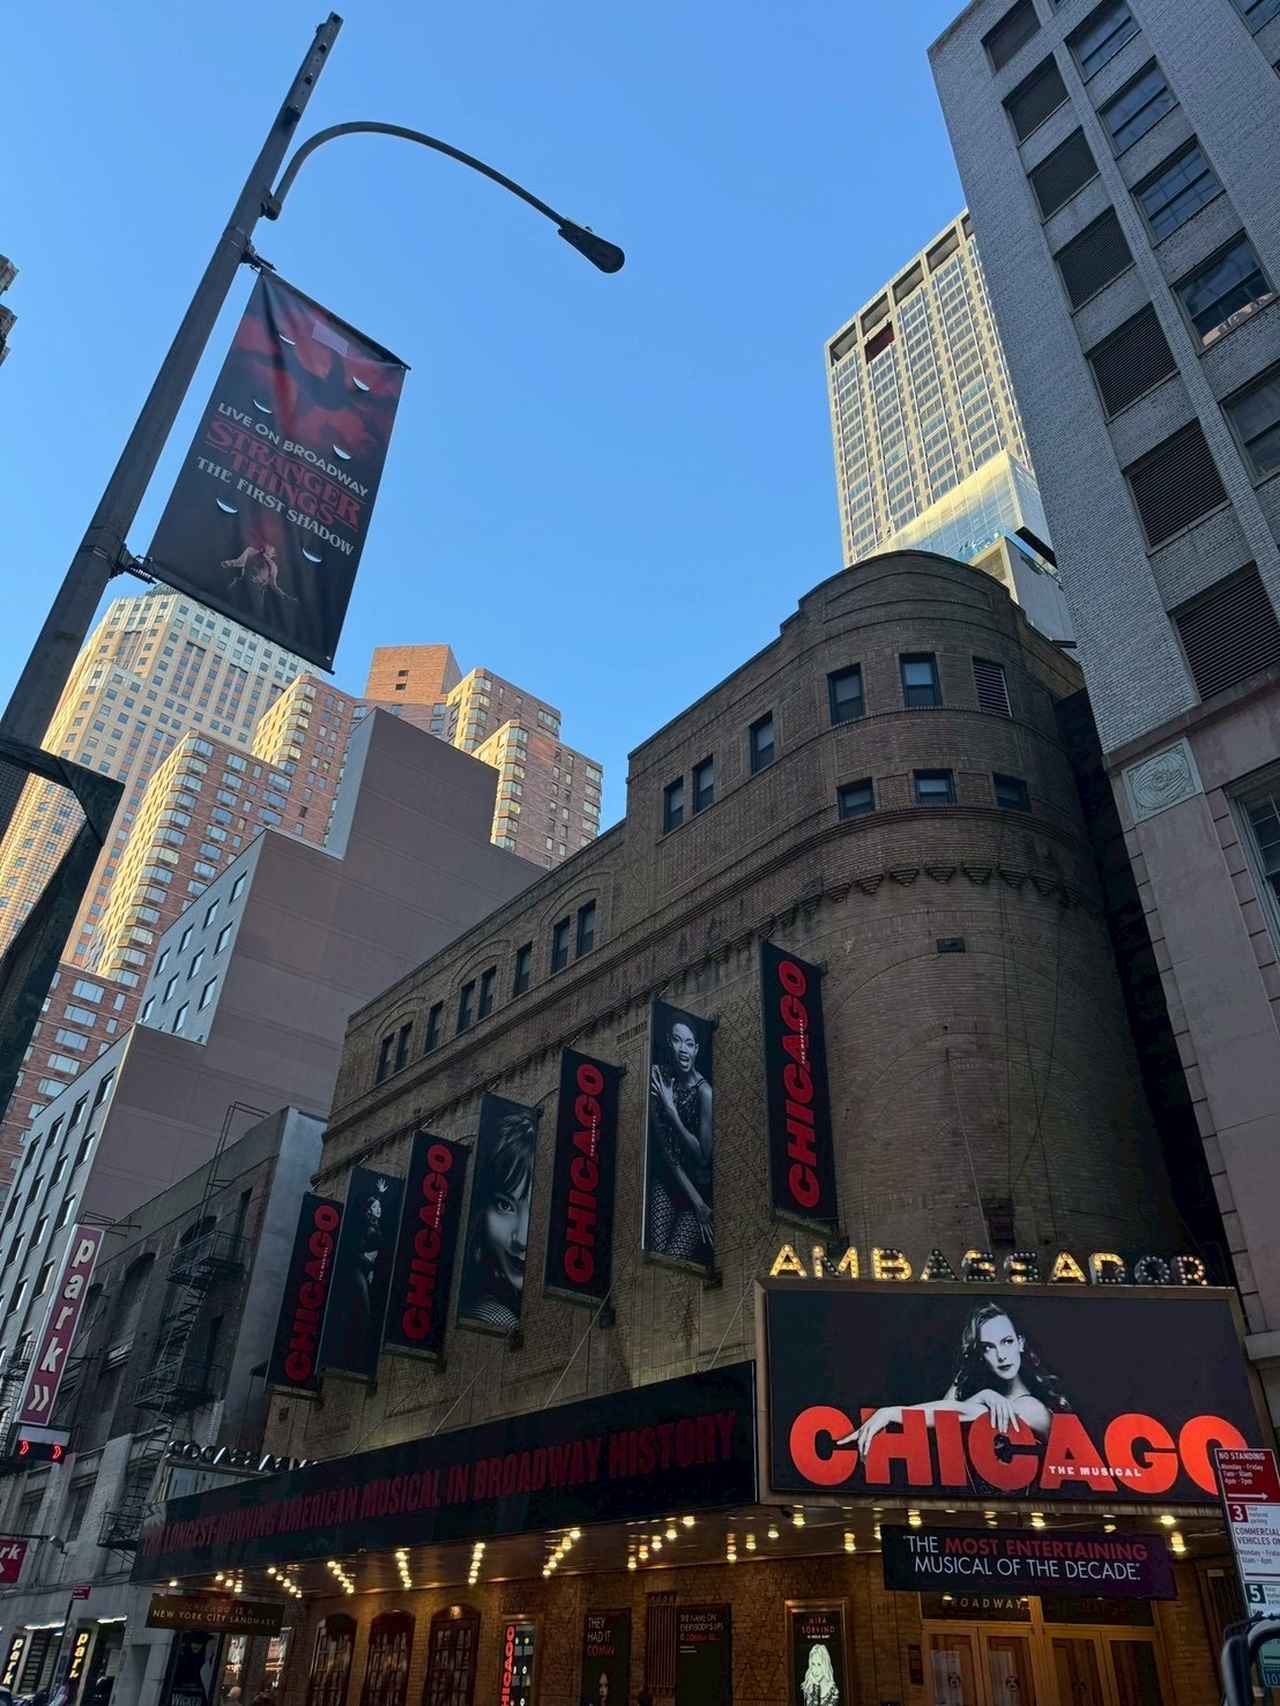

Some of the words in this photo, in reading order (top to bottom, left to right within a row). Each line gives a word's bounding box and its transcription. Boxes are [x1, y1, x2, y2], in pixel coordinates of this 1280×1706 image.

[207, 419, 361, 530] STRANGER
[218, 402, 253, 428] LIVE
[255, 423, 280, 445] ON
[282, 440, 369, 497] BROADWAY
[196, 456, 233, 484] THE
[236, 477, 286, 513] FIRST
[285, 508, 355, 556] SHADOW
[230, 450, 337, 527] THINGS
[778, 959, 820, 1208] CHICAGO
[564, 1063, 605, 1284] CHICAGO
[402, 1143, 452, 1341] CHICAGO
[769, 1243, 1209, 1287] AMBASSADOR
[40, 1238, 96, 1374] park
[284, 1204, 340, 1382] CHICAGO
[360, 1470, 440, 1517] MUSICAL
[447, 1462, 469, 1506] IN
[474, 1438, 601, 1501] BROADWAY
[790, 1405, 1249, 1497] CHICAGO
[1049, 1465, 1075, 1475] THE
[1080, 1466, 1142, 1477] MUSICAL
[1219, 1452, 1229, 1460] NO
[1231, 1452, 1266, 1461] STANDING
[1232, 1504, 1244, 1520] 3
[1235, 1527, 1280, 1536] COMMERCIAL
[1237, 1536, 1271, 1545] VEHICLES
[914, 1556, 993, 1576] MUSICAL
[997, 1558, 1021, 1577] OF
[1026, 1559, 1061, 1578] THE
[944, 1537, 998, 1557] MOST
[1005, 1539, 1148, 1561] ENTERTAINING
[152, 1609, 175, 1618] NEW
[178, 1610, 202, 1621] YORK
[206, 1613, 227, 1624] CITY
[229, 1614, 276, 1626] LANDMARK
[1249, 1584, 1261, 1602] 5
[2, 1639, 24, 1685] park
